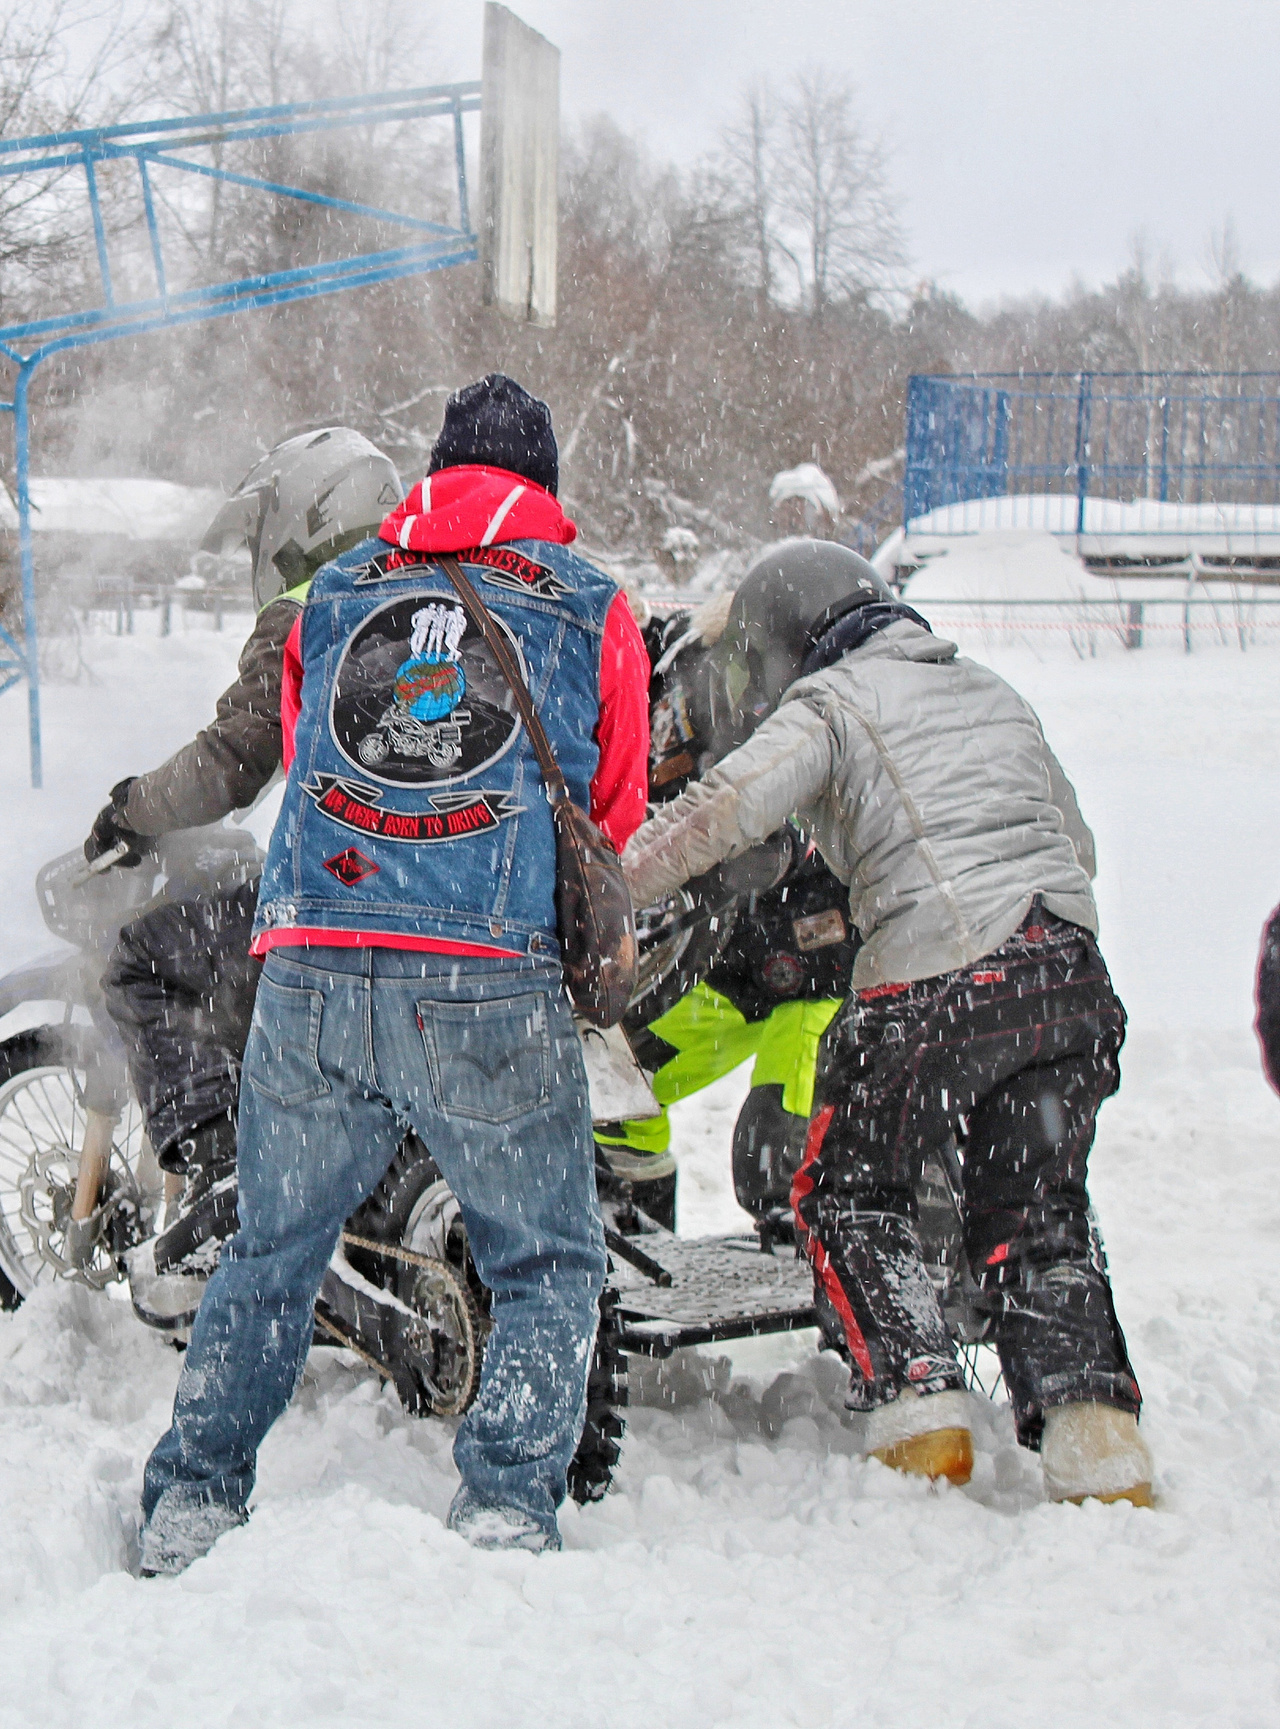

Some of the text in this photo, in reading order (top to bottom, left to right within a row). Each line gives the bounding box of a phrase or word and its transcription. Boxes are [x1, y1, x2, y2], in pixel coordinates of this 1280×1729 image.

[325, 788, 490, 837] WE WERE BORN TO DRIVE
